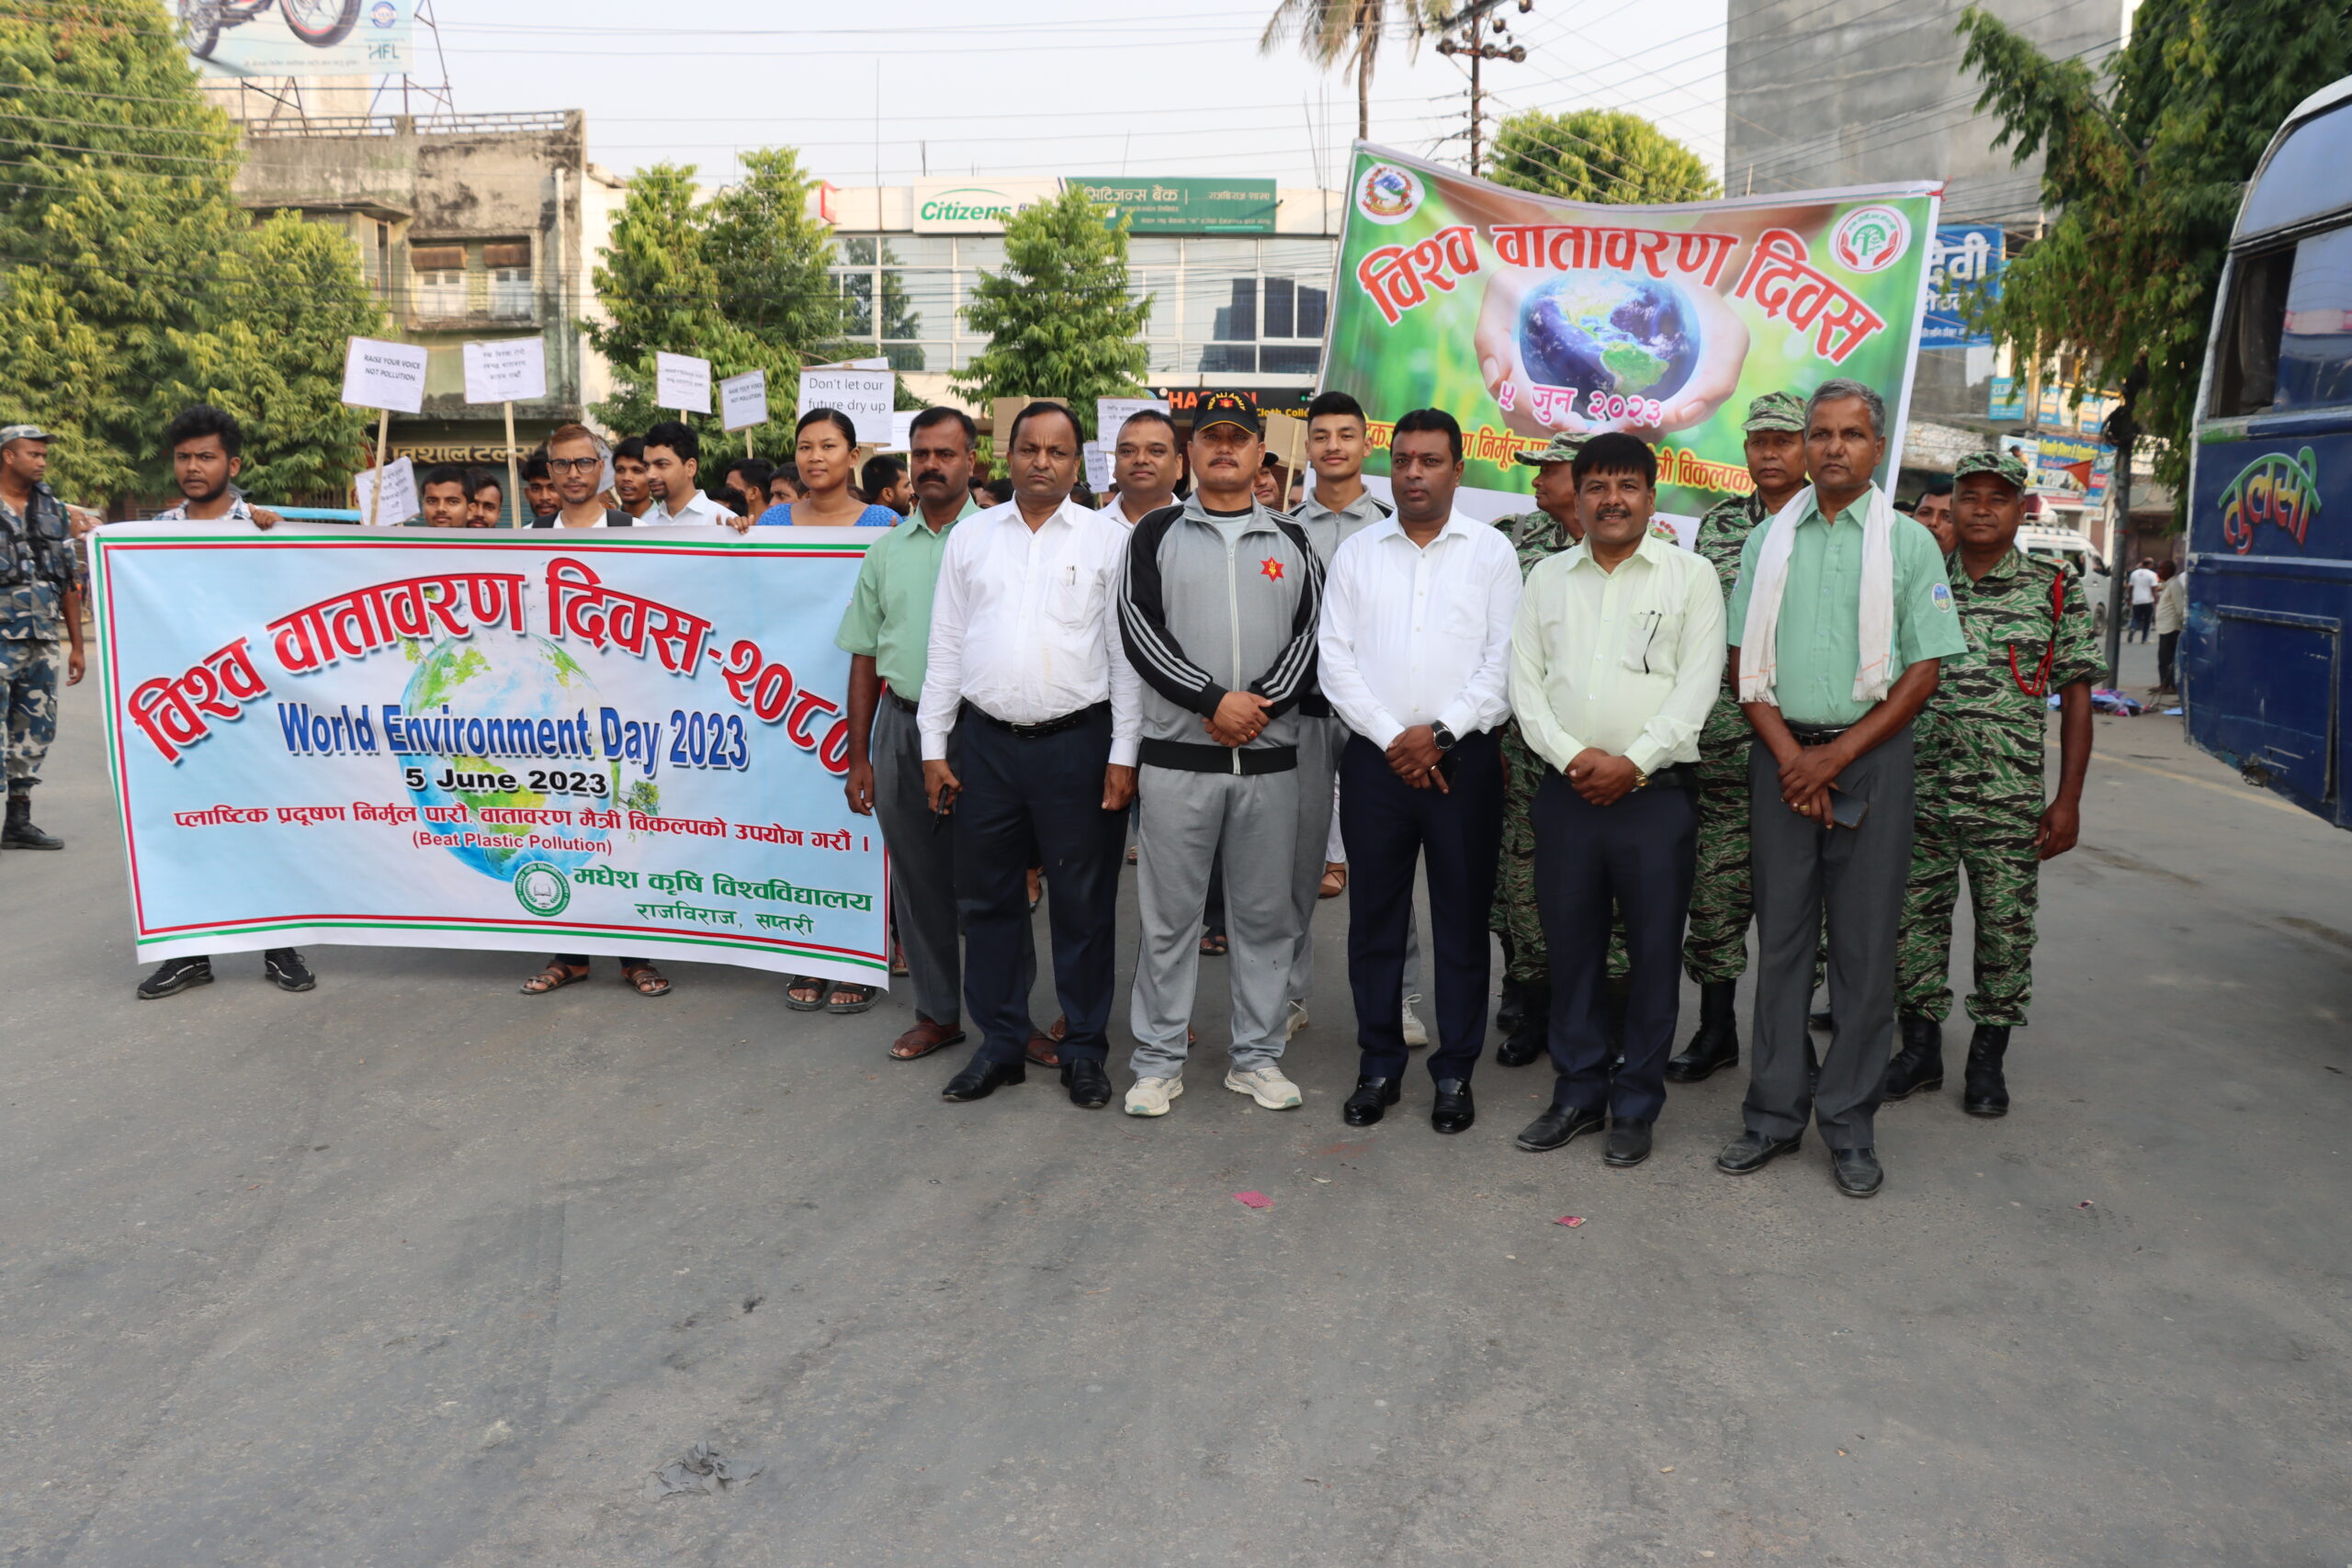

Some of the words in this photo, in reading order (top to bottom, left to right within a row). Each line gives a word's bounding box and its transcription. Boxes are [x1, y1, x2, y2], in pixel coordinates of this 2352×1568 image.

[1152, 185, 1179, 201] बैंक
[921, 201, 1012, 220] Citizens
[1358, 226, 1480, 325] विश्व
[1490, 224, 1741, 289] वातावरण
[1733, 228, 1886, 366] दिवस
[364, 355, 381, 364] RAISE
[401, 361, 421, 369] VOICE
[365, 367, 379, 376] NOT
[380, 369, 415, 381] POLLUTION
[809, 378, 841, 389] Don't
[845, 378, 859, 390] let
[864, 381, 884, 390] our
[808, 398, 843, 410] future
[847, 399, 867, 413] dry
[871, 402, 887, 413] up
[1499, 382, 1515, 410] ५
[1532, 386, 1577, 424] जुन
[1588, 391, 1662, 426] २०२३
[1476, 425, 1526, 469] निर्मूल
[2218, 446, 2323, 556] तुलसी
[128, 636, 269, 763] विश्व
[266, 572, 526, 673] वातावरण
[278, 703, 378, 754] World
[382, 705, 593, 757] Environment
[599, 706, 661, 777] Day
[670, 709, 748, 769] 2023
[405, 768, 425, 788] 5
[436, 769, 516, 790] June
[528, 770, 606, 794] 2023
[174, 805, 268, 827] प्लाष्टिक
[277, 805, 345, 826] प्रदूषण
[480, 807, 571, 826] वातावरण
[579, 807, 621, 830] मैत्री
[628, 810, 728, 839] विकल्पको
[735, 823, 804, 847] उपयोग
[413, 830, 459, 849] (Beat
[465, 832, 524, 849] Plastic
[529, 834, 613, 855] Pollution)
[573, 864, 639, 889] मधेश
[648, 869, 704, 896] कृषि
[713, 874, 874, 912] विश्वविद्यालय
[756, 911, 814, 935] सप्तरी
